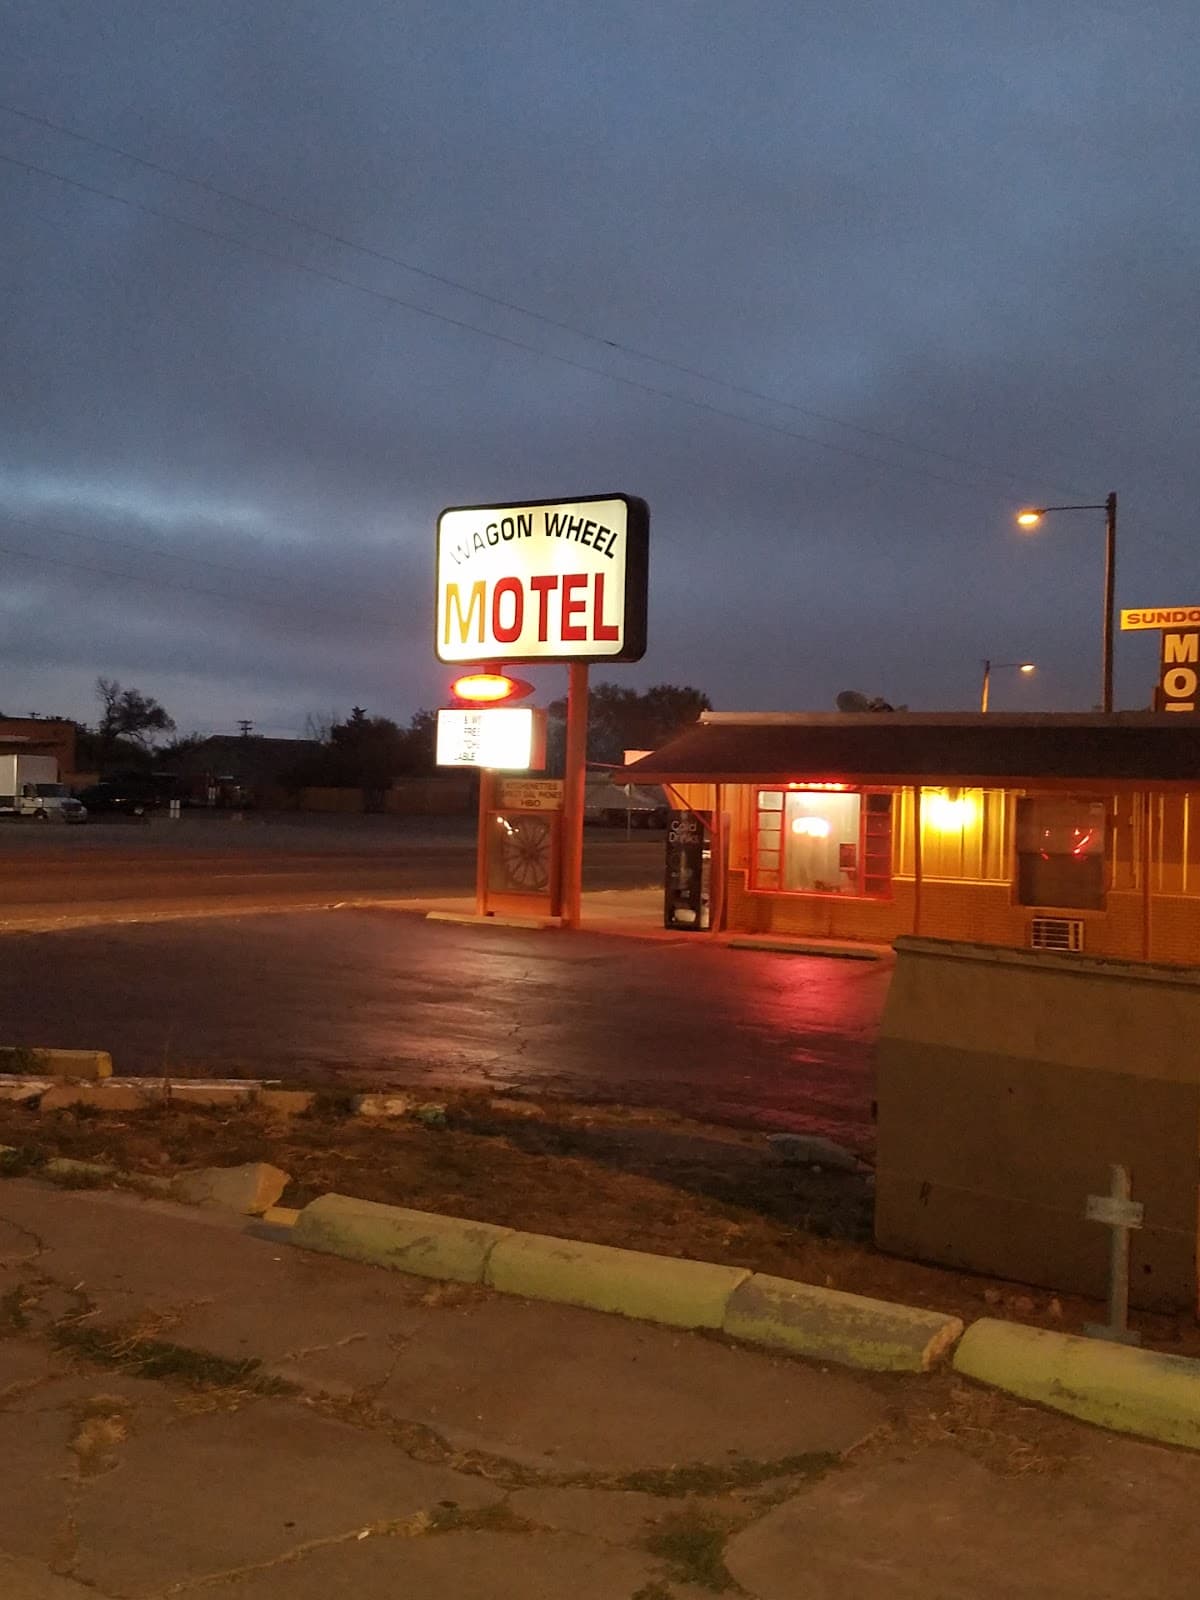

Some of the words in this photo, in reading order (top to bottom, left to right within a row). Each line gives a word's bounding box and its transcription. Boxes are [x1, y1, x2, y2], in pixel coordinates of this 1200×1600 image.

[450, 513, 533, 565] WAGON
[545, 513, 618, 559] WHEEL
[444, 573, 619, 644] MOTEL
[1127, 611, 1200, 624] SUNDO
[520, 799, 541, 807] HBO
[672, 820, 697, 831] Cold
